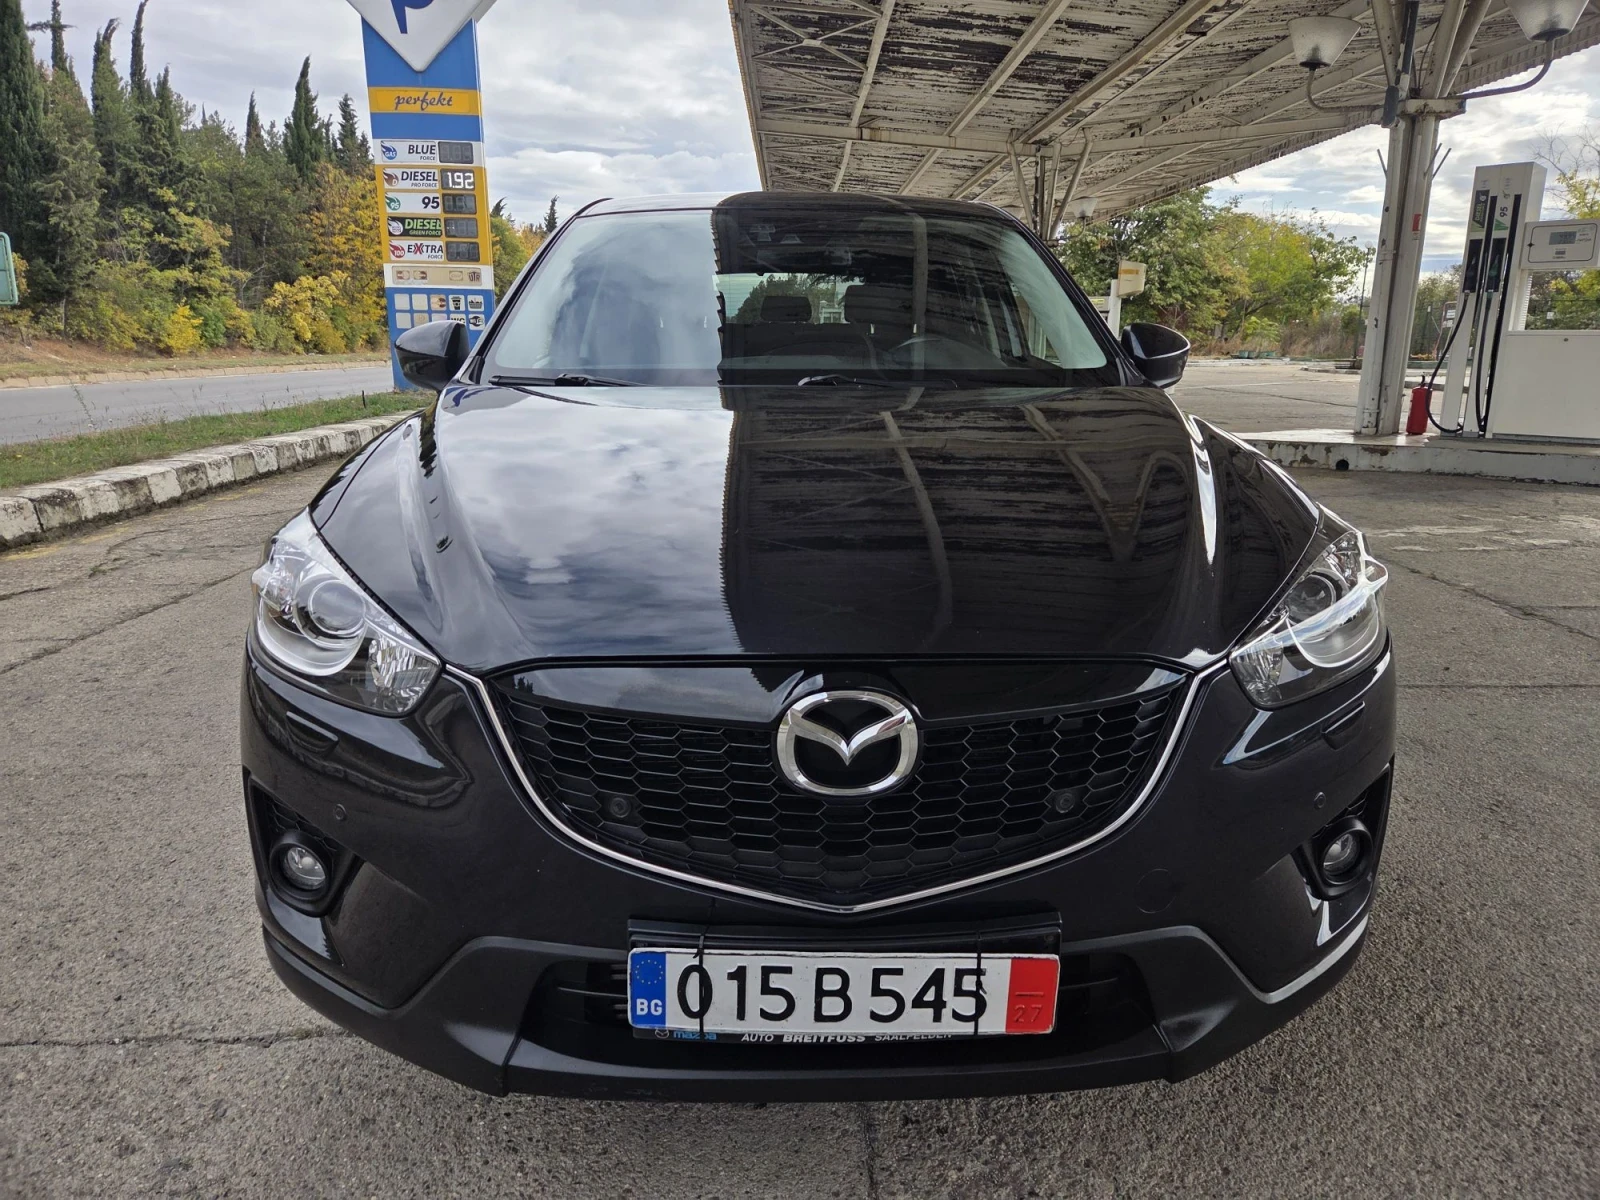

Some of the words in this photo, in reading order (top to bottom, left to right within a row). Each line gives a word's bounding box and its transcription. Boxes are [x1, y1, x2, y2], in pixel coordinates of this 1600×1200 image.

[394, 92, 453, 111] perfekt
[408, 144, 436, 155] BLUE
[401, 171, 438, 181] DIESEL
[447, 172, 474, 189] 1.92
[422, 196, 440, 209] 95
[1500, 206, 1508, 217] 95
[405, 218, 442, 230] DIESEL
[407, 243, 443, 254] EXTRA
[636, 998, 663, 1015] BG
[1014, 1004, 1041, 1023] 27
[741, 1033, 774, 1042] AUTO
[782, 1033, 866, 1043] BREITFUSS
